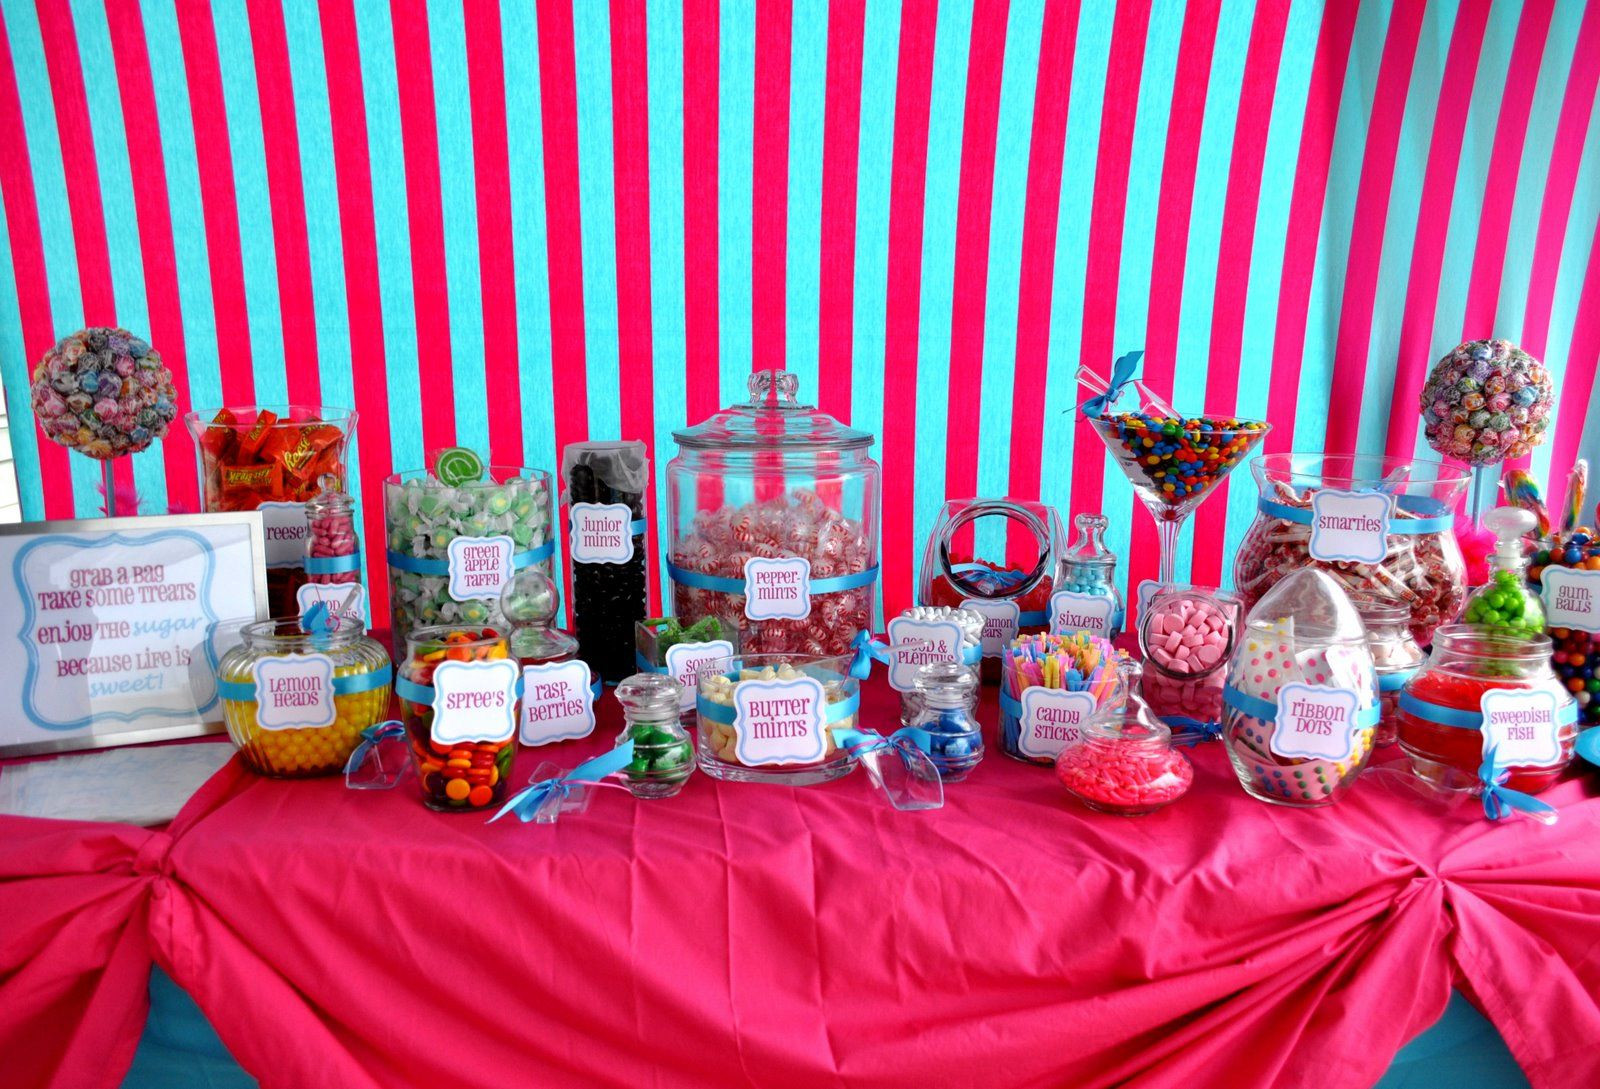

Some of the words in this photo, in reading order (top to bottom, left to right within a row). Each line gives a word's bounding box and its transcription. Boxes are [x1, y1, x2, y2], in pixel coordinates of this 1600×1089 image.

[582, 516, 621, 532] junior
[463, 545, 500, 559] green
[117, 565, 129, 585] a
[85, 587, 135, 608] some
[1558, 584, 1593, 598] gum-
[37, 620, 93, 645] enjoy
[132, 616, 203, 639] sugar
[175, 645, 191, 666] is
[938, 639, 948, 653] &
[90, 671, 164, 698] sweet!
[269, 675, 321, 693] Lemon
